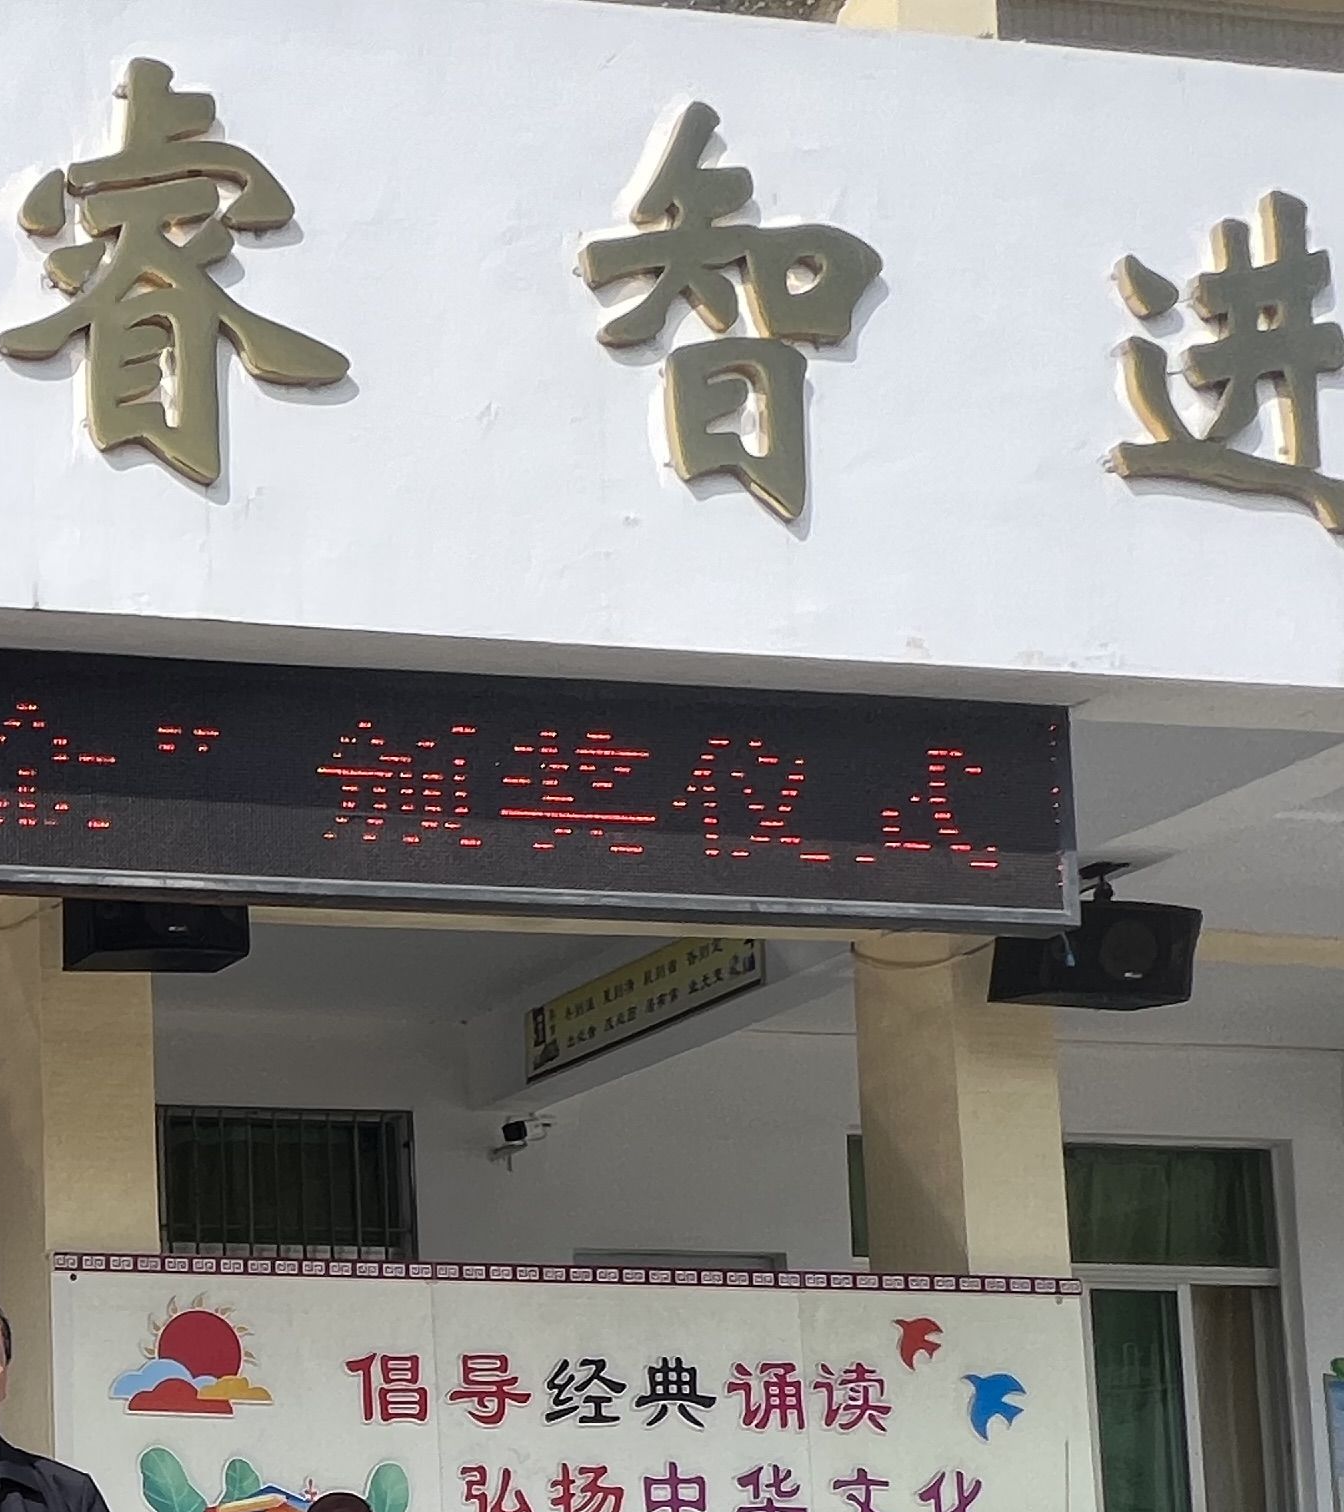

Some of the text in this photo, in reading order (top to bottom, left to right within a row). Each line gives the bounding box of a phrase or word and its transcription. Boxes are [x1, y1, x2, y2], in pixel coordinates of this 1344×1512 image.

[345, 1352, 893, 1434] 倡导经典诵读
